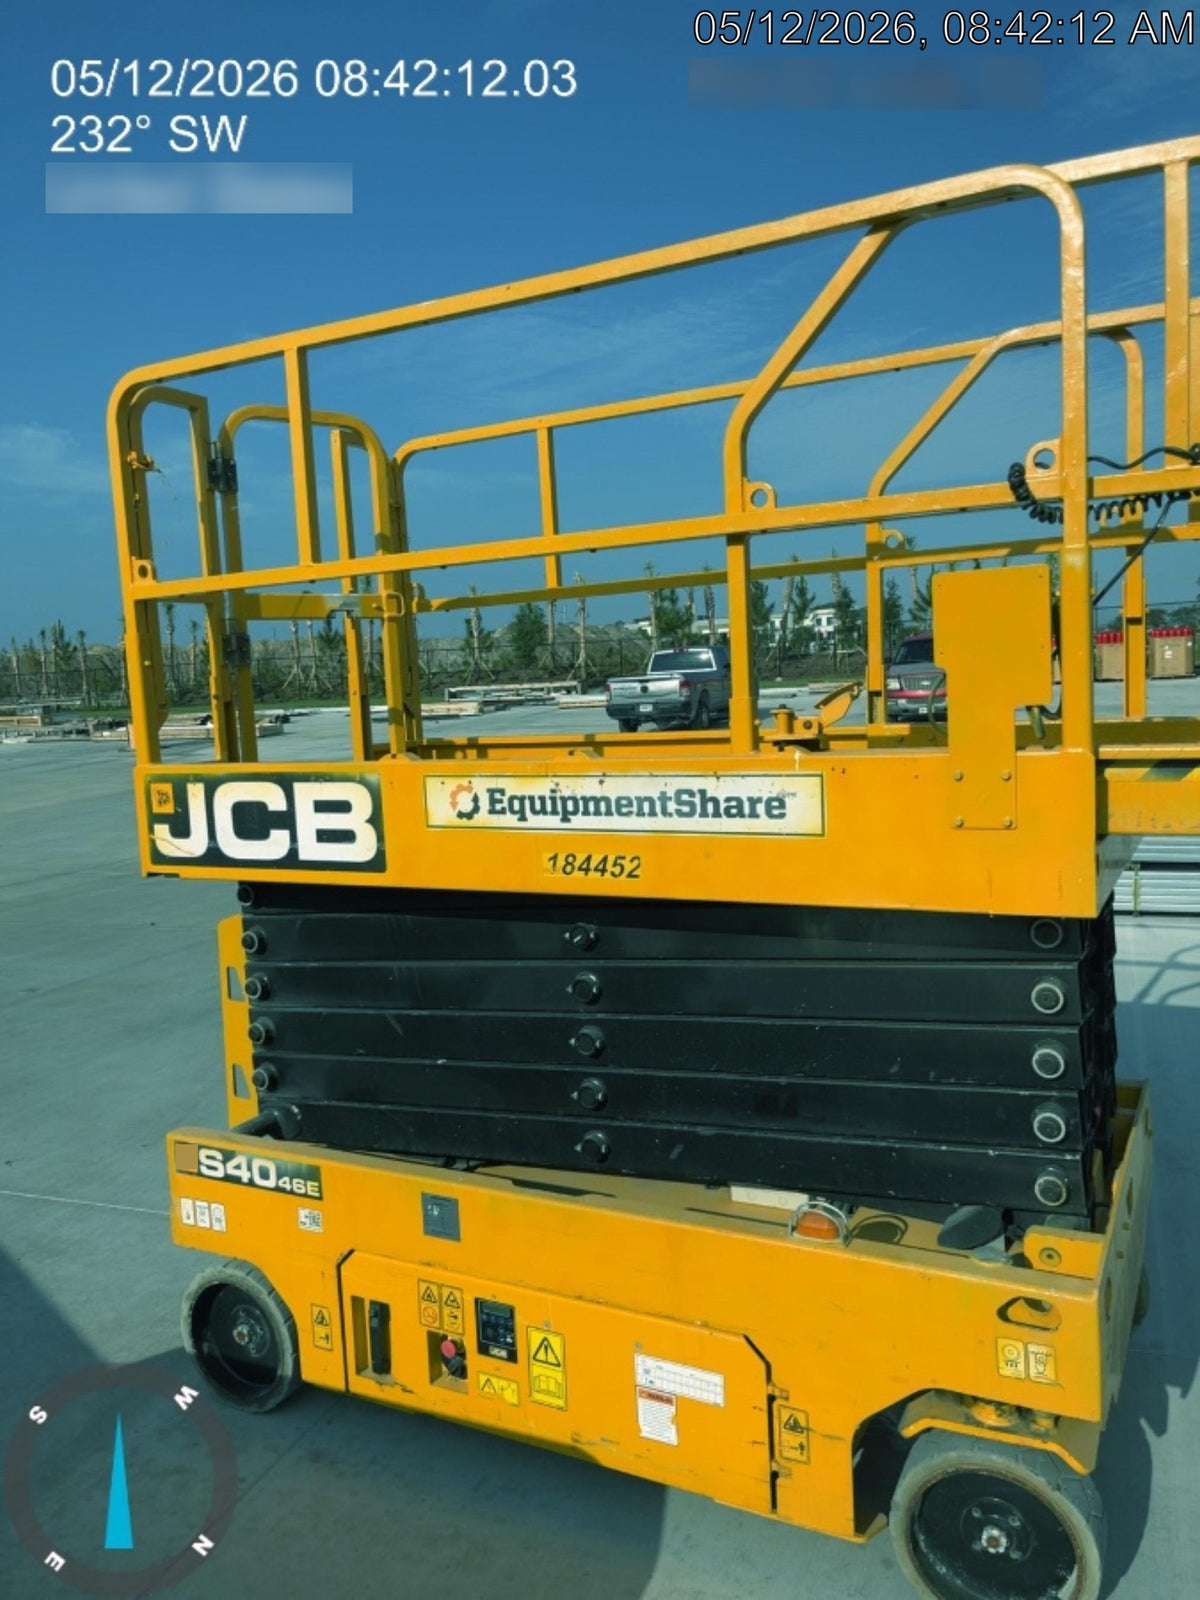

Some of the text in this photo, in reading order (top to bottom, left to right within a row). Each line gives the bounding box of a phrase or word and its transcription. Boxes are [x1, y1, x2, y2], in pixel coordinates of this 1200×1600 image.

[153, 781, 378, 863] JCB
[485, 787, 788, 823] EquipmentShare
[547, 852, 641, 879] 184452
[199, 1148, 321, 1197] S40 46E
